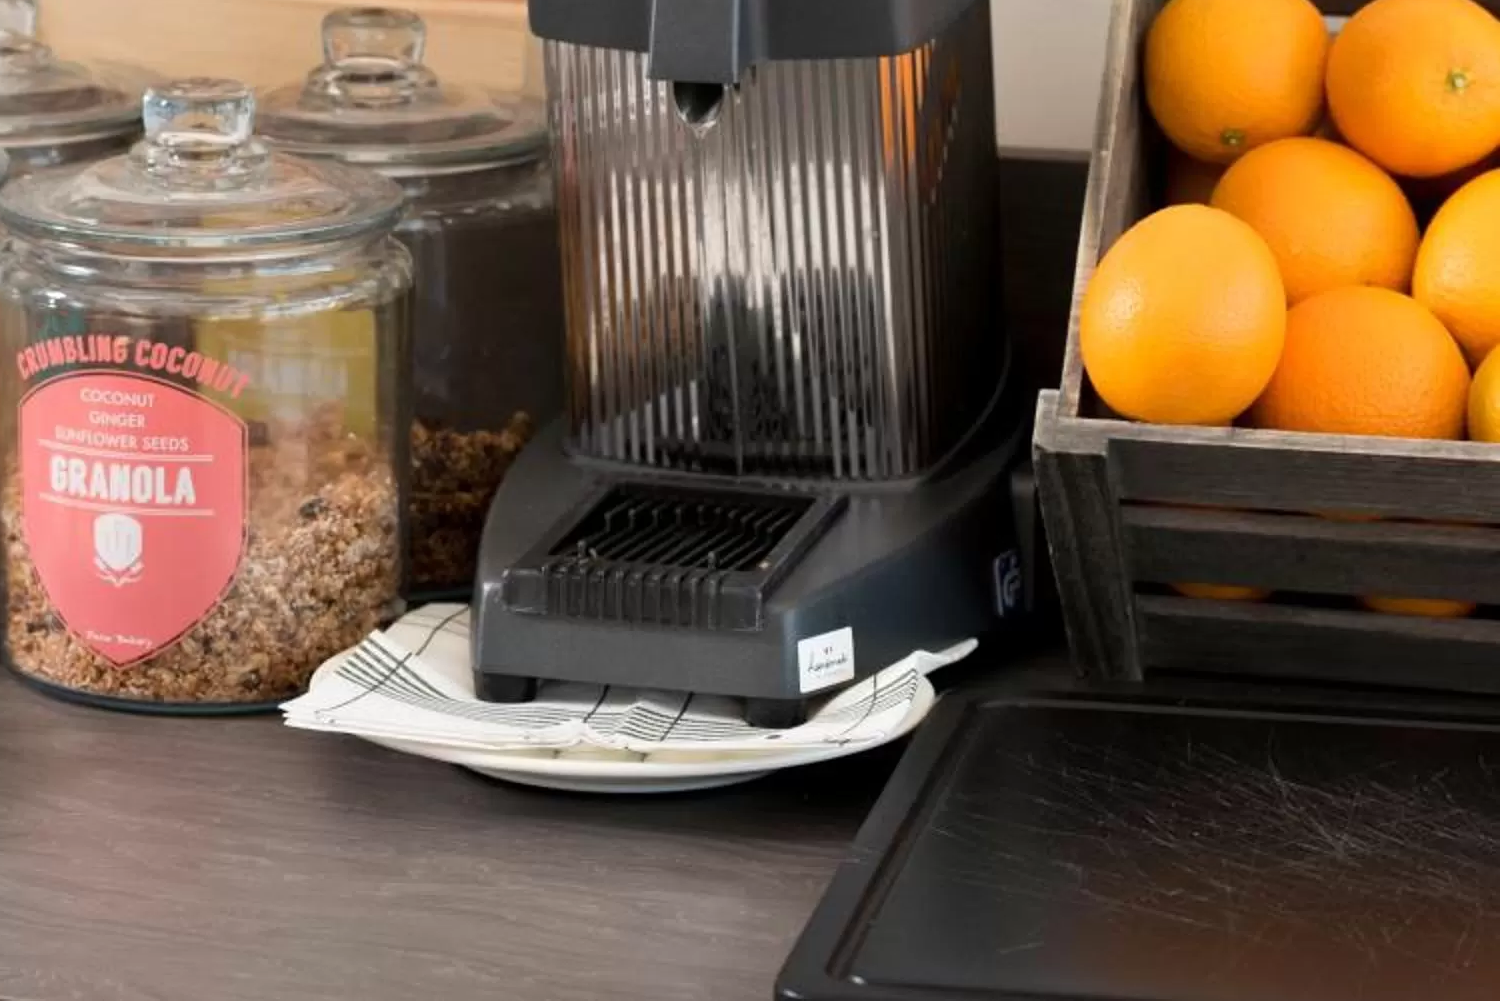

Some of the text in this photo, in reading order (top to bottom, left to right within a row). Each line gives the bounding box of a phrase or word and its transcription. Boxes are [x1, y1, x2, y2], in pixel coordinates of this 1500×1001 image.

[17, 334, 127, 380] CRUMBLING
[134, 340, 249, 398] COCONUT
[80, 387, 155, 407] COCONUT
[89, 410, 145, 428] GINGER
[55, 425, 189, 451] SUNFLOWER SEEDS
[50, 454, 197, 505] GRANOLA
